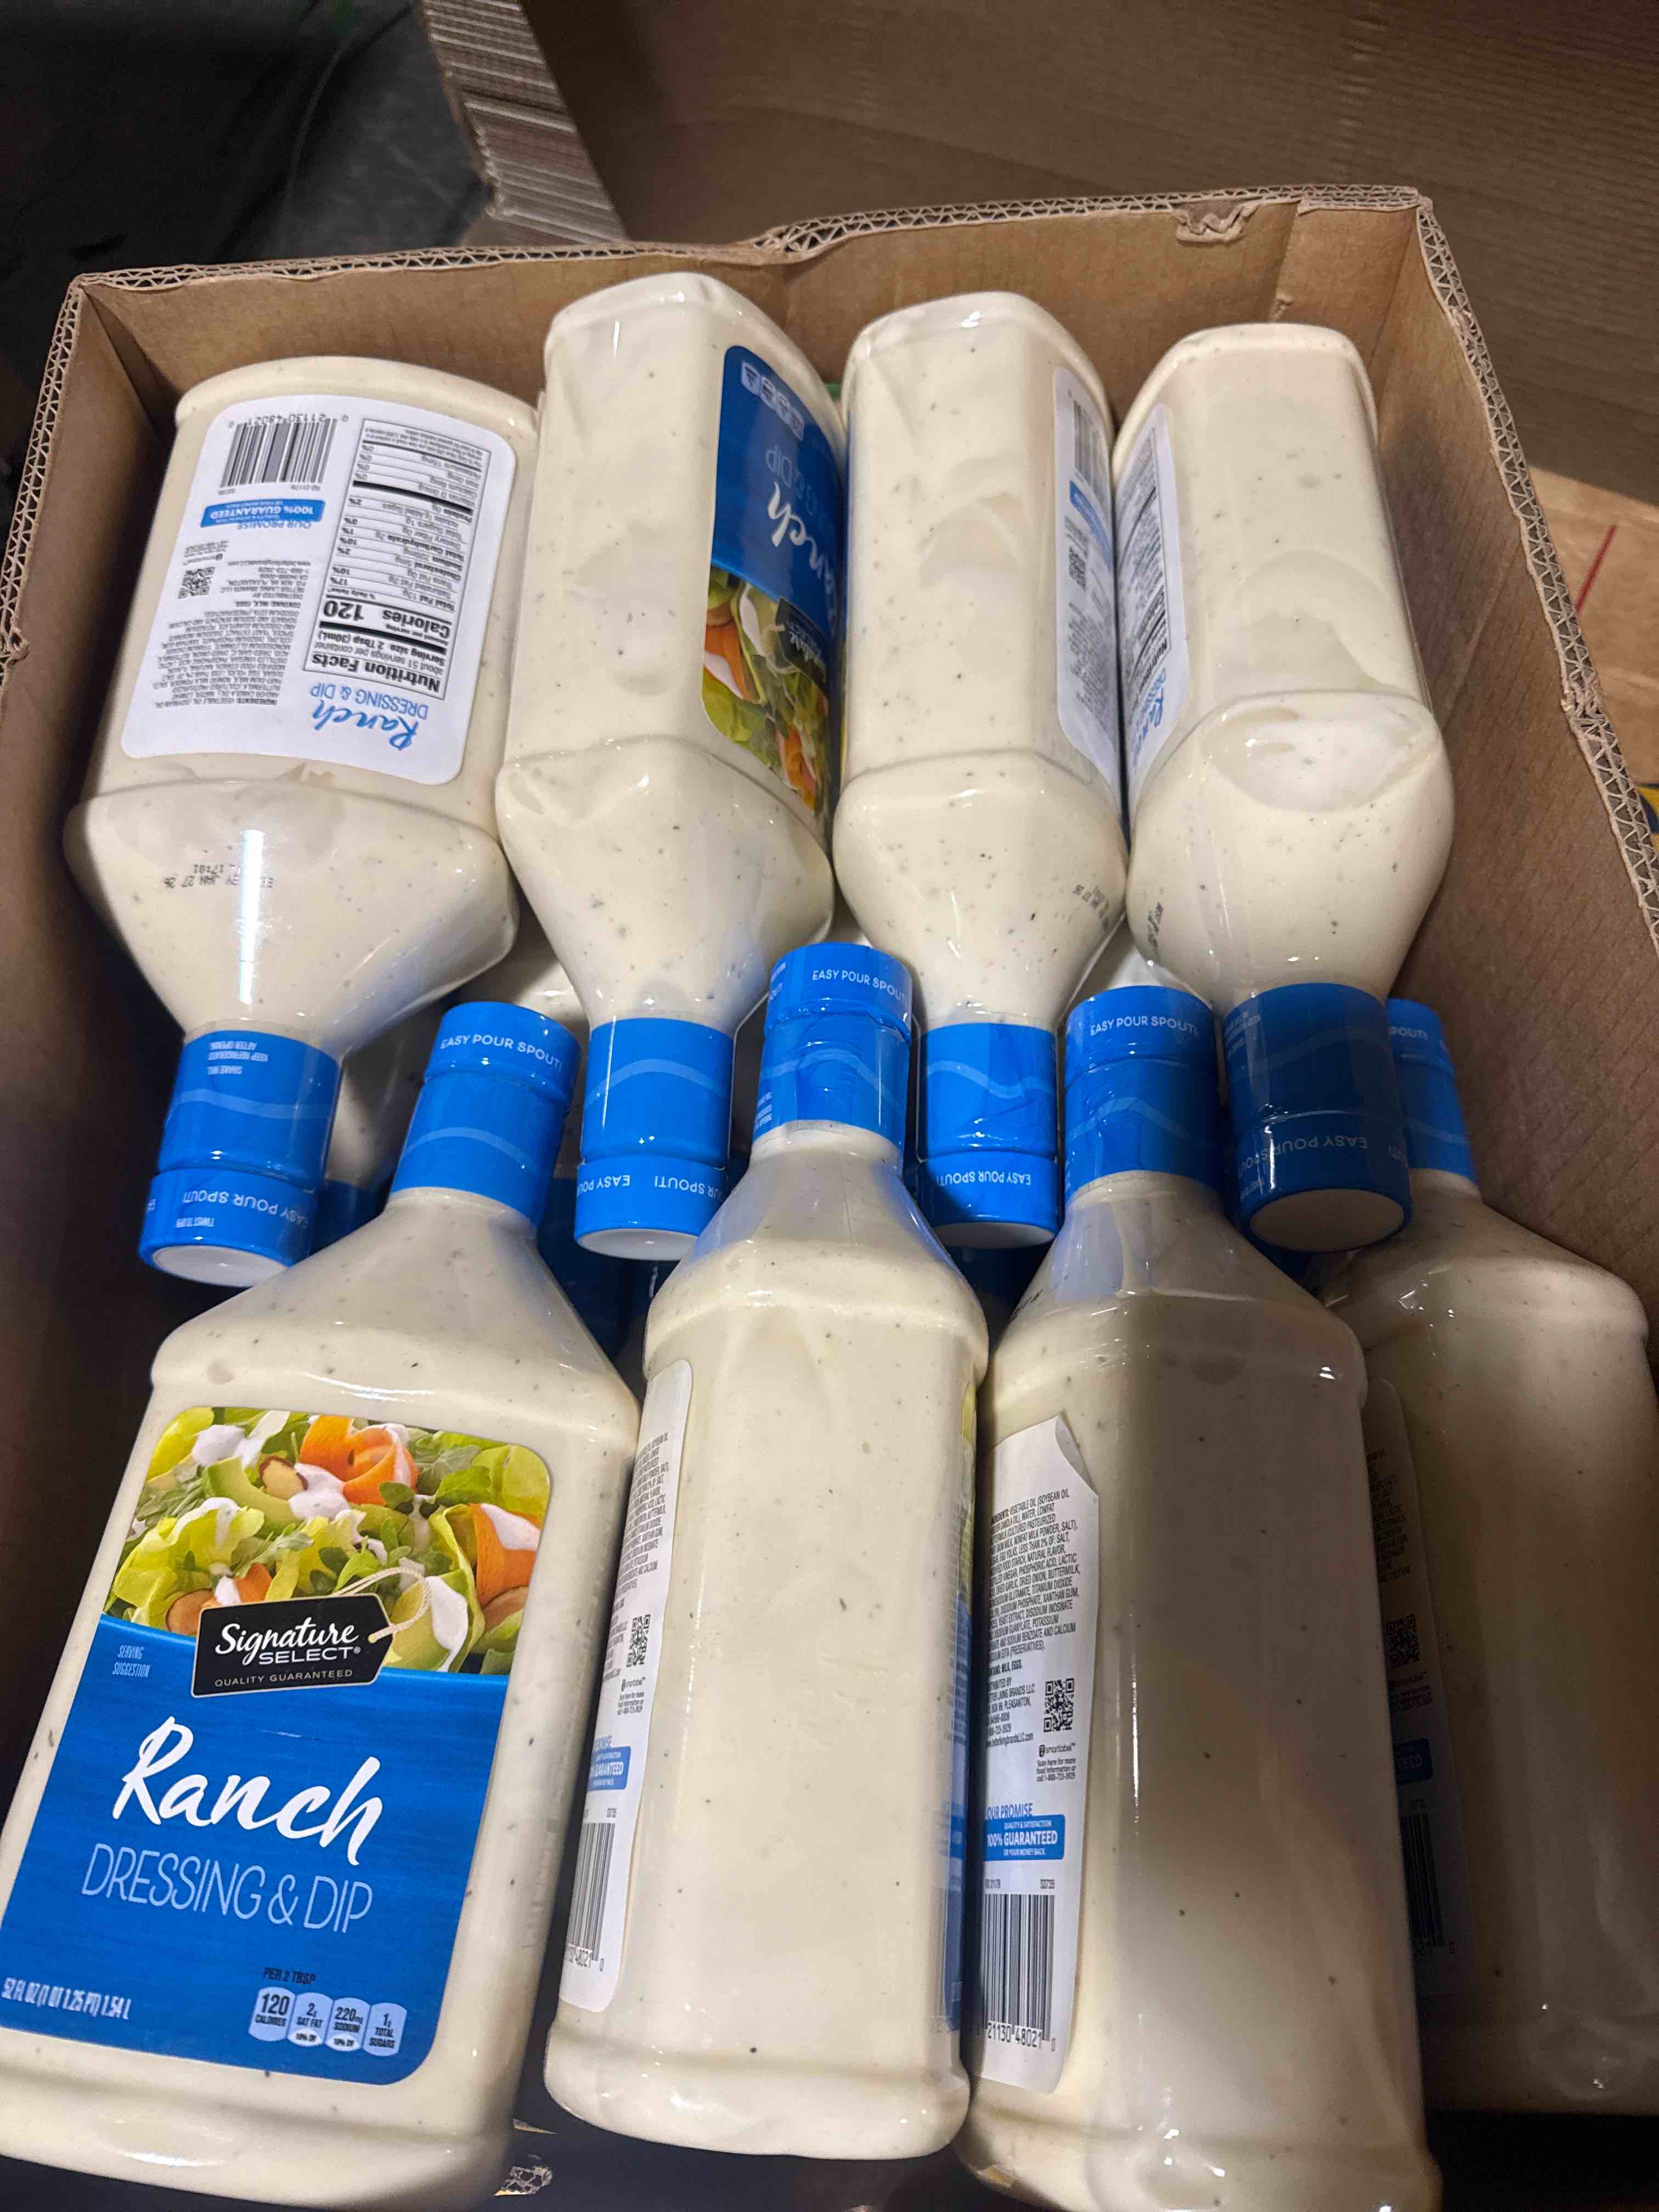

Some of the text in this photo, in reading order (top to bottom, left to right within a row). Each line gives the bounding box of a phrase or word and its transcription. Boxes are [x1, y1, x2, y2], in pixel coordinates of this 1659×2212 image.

[210, 505, 313, 518] 100% GUARANTEED
[236, 519, 311, 529] OUR PROMISE
[419, 594, 433, 605] Fat
[323, 600, 450, 638] Calories 120
[315, 641, 353, 654] container
[318, 630, 445, 667] Serving size 2 Tbsp (30mL)
[353, 646, 369, 657] per
[370, 650, 406, 665] servings
[312, 654, 440, 693] Nutrition Facts
[419, 662, 443, 675] about
[309, 682, 428, 719] DRESSING & DIP
[311, 699, 419, 751] Ranch
[812, 970, 905, 1002] EASY POUR SPOUT
[1090, 1019, 1115, 1036] EASY
[1116, 1015, 1148, 1028] POUR
[441, 1035, 471, 1049] EASY
[472, 1034, 514, 1049] POUR
[1323, 1135, 1368, 1150] EASY
[597, 1175, 630, 1188] EASY
[978, 1170, 1004, 1183] POUR
[1006, 1172, 1031, 1186] EASY
[233, 1193, 279, 1215] POUR
[1010, 1500, 1029, 1515] VEGETABLE
[1037, 1491, 1060, 1505] (SOYBEAN
[1037, 1503, 1055, 1516] LOWFAT
[1028, 1513, 1056, 1528] PASTEURIZED
[1029, 1530, 1039, 1540] MILK
[1040, 1523, 1059, 1536] POWDER,
[1018, 1543, 1028, 1554] LESS
[1029, 1539, 1040, 1550] THAN
[1027, 1549, 1046, 1562] NATURAL
[1058, 1553, 1077, 1565] LACTIC
[1048, 1564, 1080, 1579] BUTTERMILK,
[1032, 1579, 1053, 1593] TITANIUM
[1054, 1576, 1073, 1589] DIOXIDE
[1043, 1590, 1065, 1602] XANTHAN
[1026, 1605, 1048, 1618] DISODIUM
[1032, 1615, 1059, 1627] POTASSIUM
[1044, 1627, 1053, 1637] AND
[1054, 1622, 1076, 1635] CALCIUM
[215, 1617, 359, 1666] Signature
[117, 1645, 144, 1659] SERVING
[112, 1662, 150, 1678] SUGGESTION
[215, 1669, 353, 1688] QUALITY GUARANTEED
[1009, 1685, 1026, 1697] BRANDS
[1026, 1684, 1035, 1694] LLC
[112, 1716, 383, 1866] Ranch
[988, 1803, 1032, 1819] OUR PROMISE
[988, 1831, 1058, 1847] 100% GUARANTEED
[81, 1843, 373, 1933] DRESSING & DIP
[263, 1967, 317, 1985] PER 2 TBSP
[101, 1995, 125, 2019] 1.54
[122, 1998, 132, 2020] L
[261, 1993, 291, 2016] 120
[255, 2014, 287, 2027] CALORIES
[296, 2016, 324, 2029] SAT FAT
[334, 2022, 361, 2033] SODIUM
[375, 2027, 394, 2038] TOTAL
[988, 2022, 1056, 2052] 21130 48021 0
[369, 2038, 396, 2049] SUGARS
